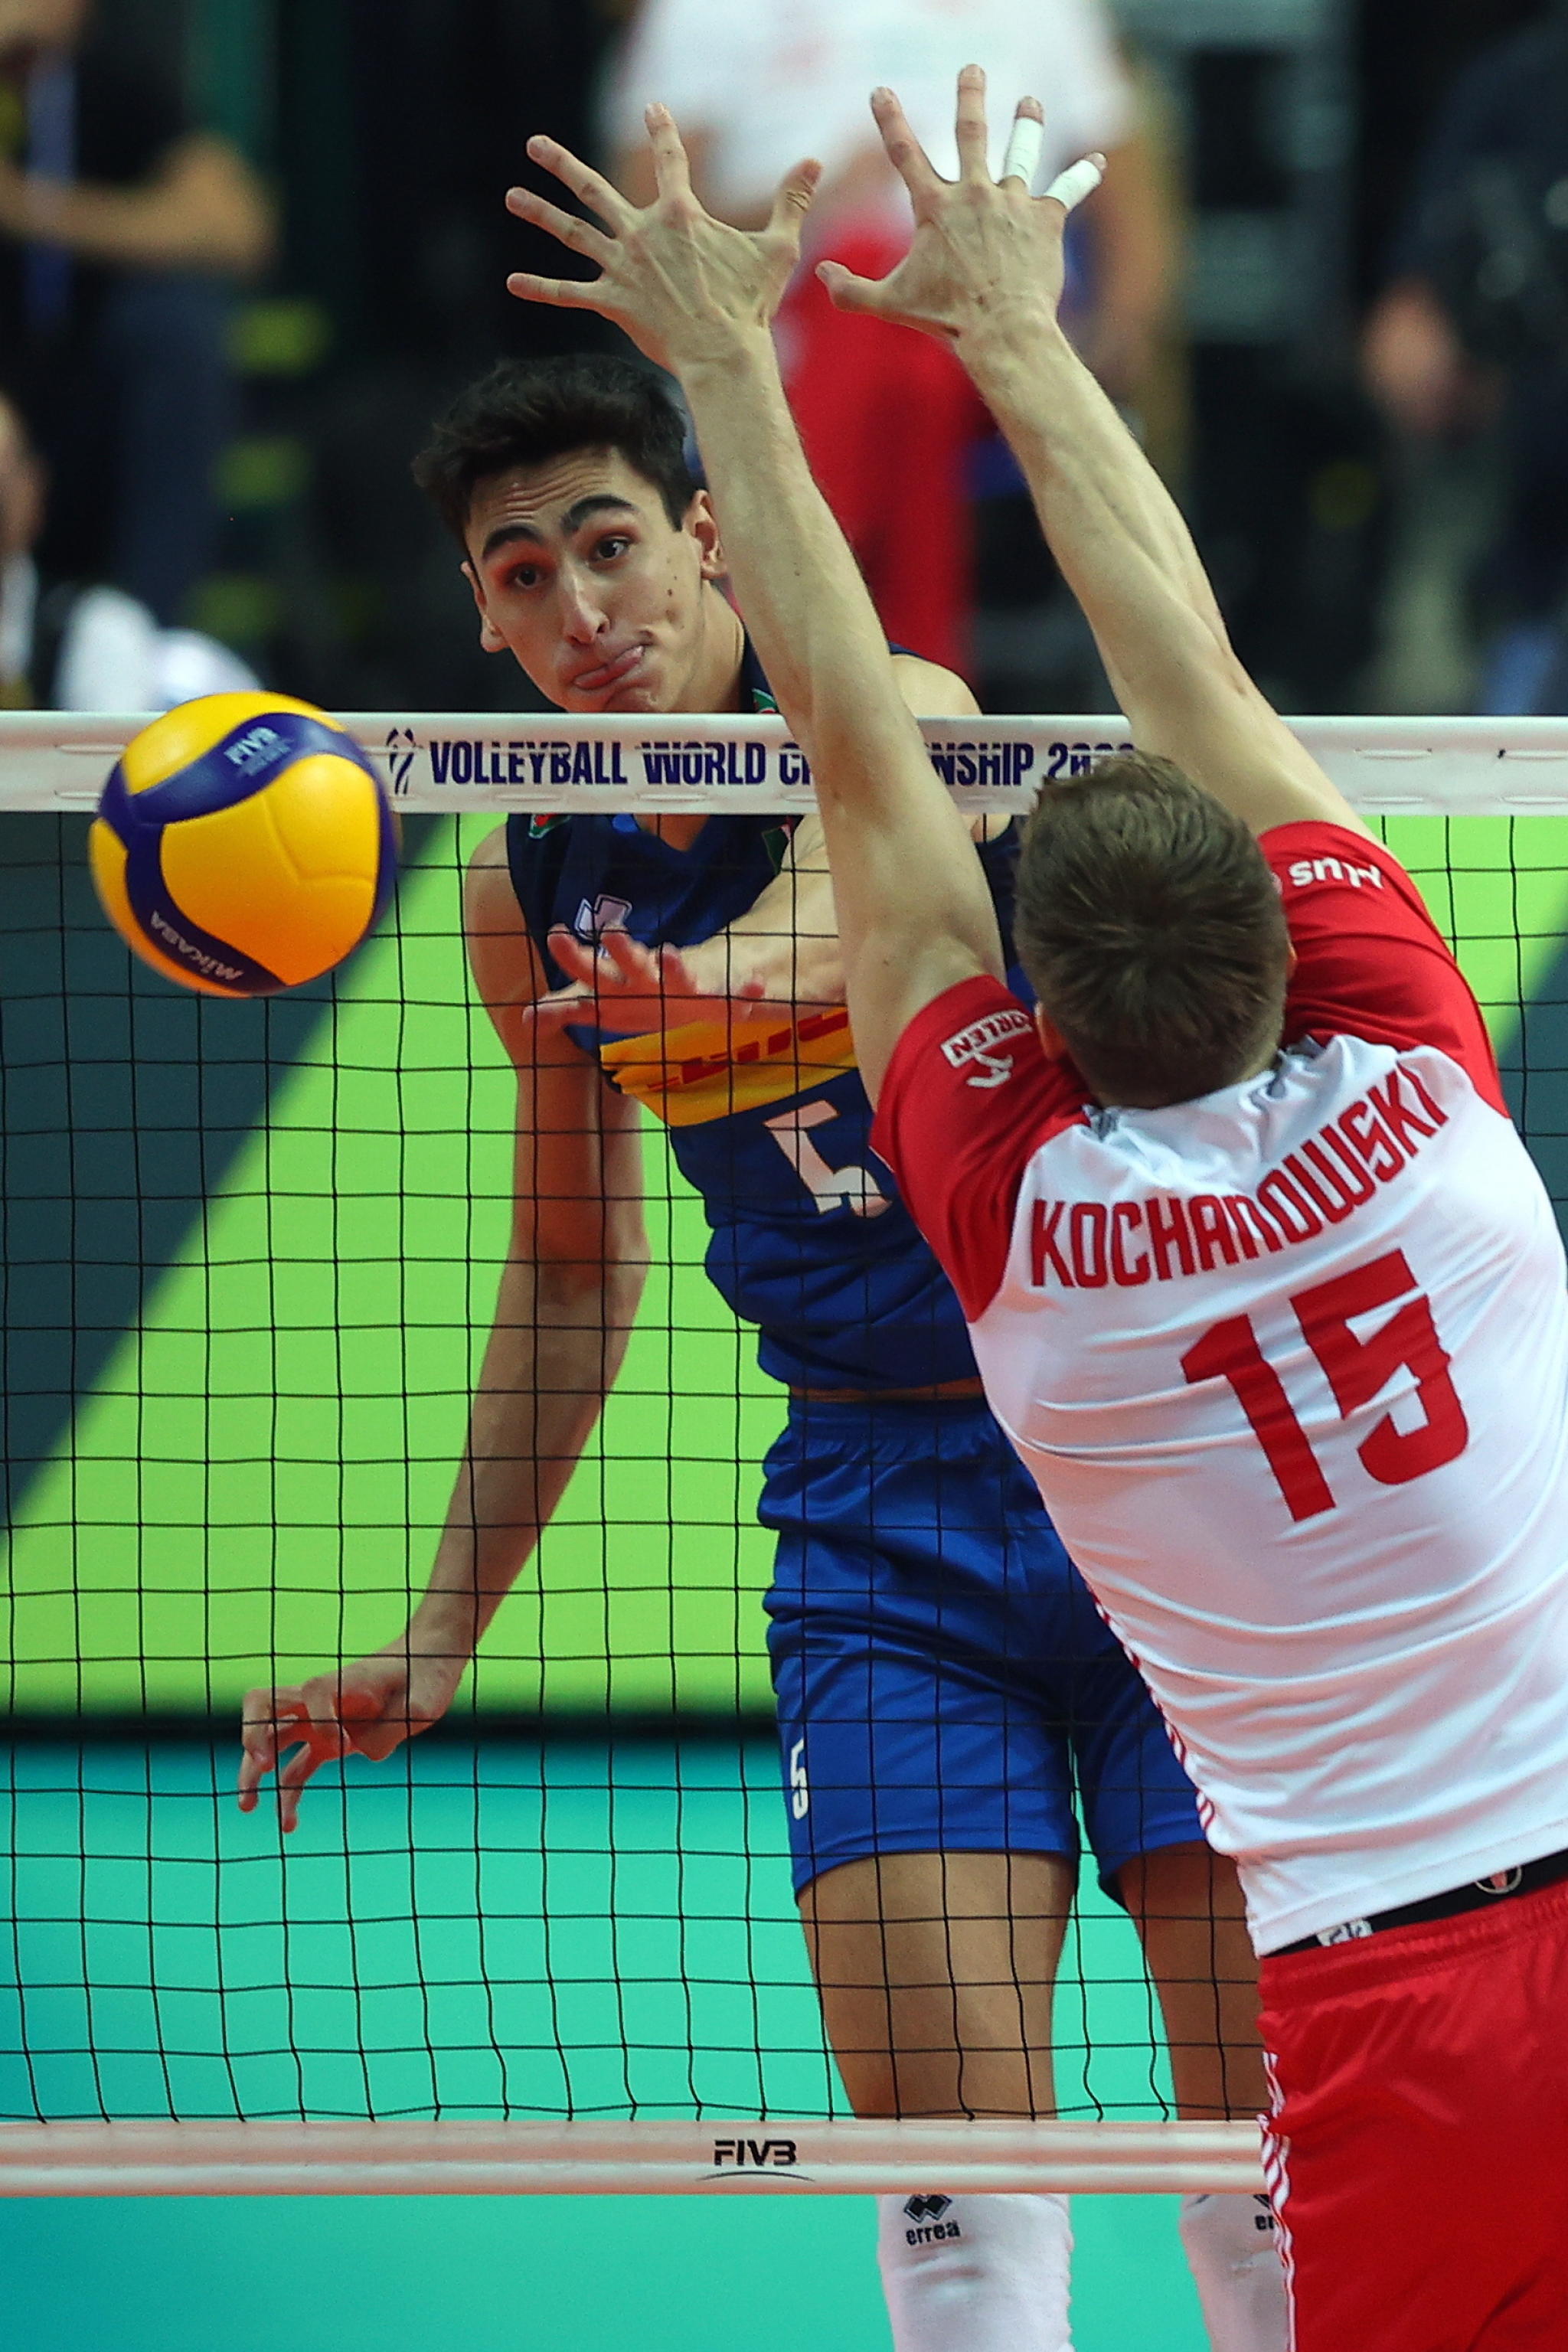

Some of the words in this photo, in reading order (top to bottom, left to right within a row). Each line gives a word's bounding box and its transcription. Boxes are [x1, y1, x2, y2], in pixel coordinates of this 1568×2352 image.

[430, 740, 628, 785] VOLLEYBALL
[641, 740, 766, 786] WORLD
[151, 909, 244, 981] MIKASA
[948, 1012, 1028, 1060] ORLEN
[763, 1099, 893, 1219] 5
[1031, 1060, 1449, 1289] KOCHANOWSKI
[1180, 1248, 1468, 1524] 15
[714, 2139, 797, 2167] FIVB
